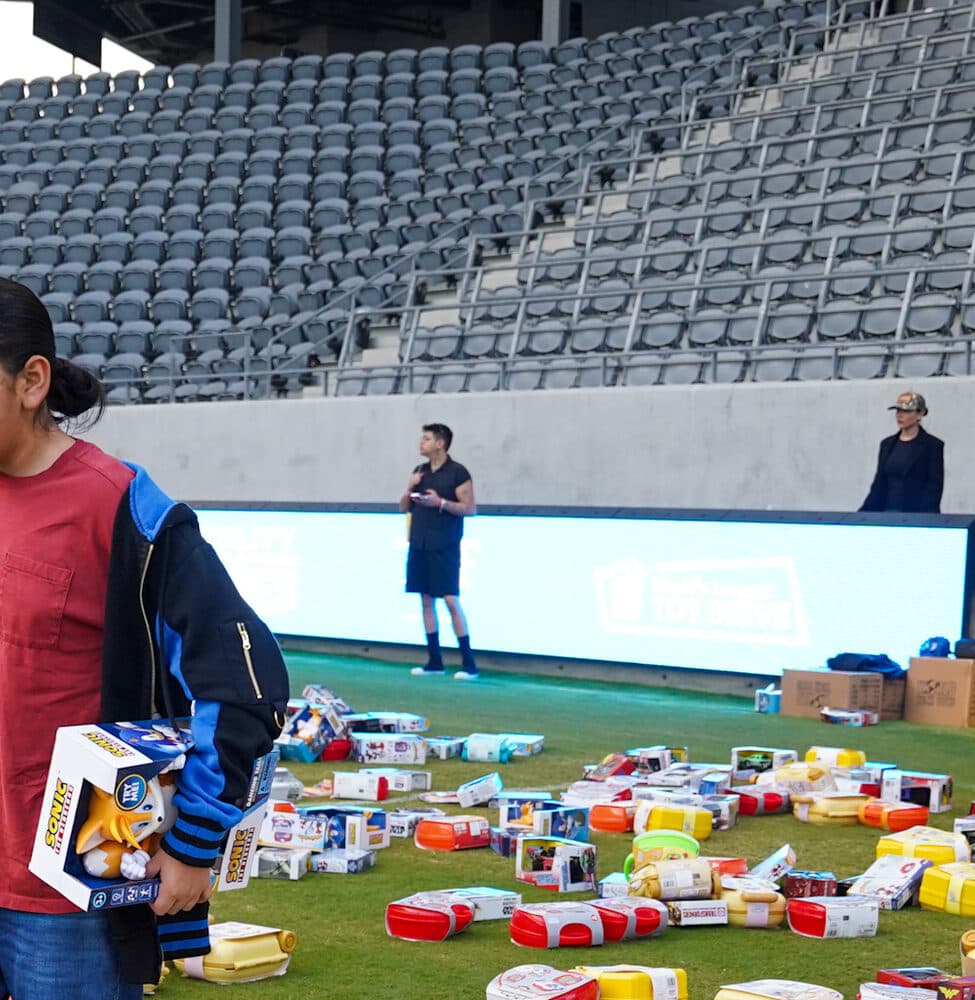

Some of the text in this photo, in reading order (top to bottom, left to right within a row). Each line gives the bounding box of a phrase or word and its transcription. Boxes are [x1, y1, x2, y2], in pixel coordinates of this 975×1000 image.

[82, 732, 125, 758] SONIC
[122, 782, 133, 803] TRY
[45, 777, 68, 850] SONIC
[226, 829, 248, 883] SONIC
